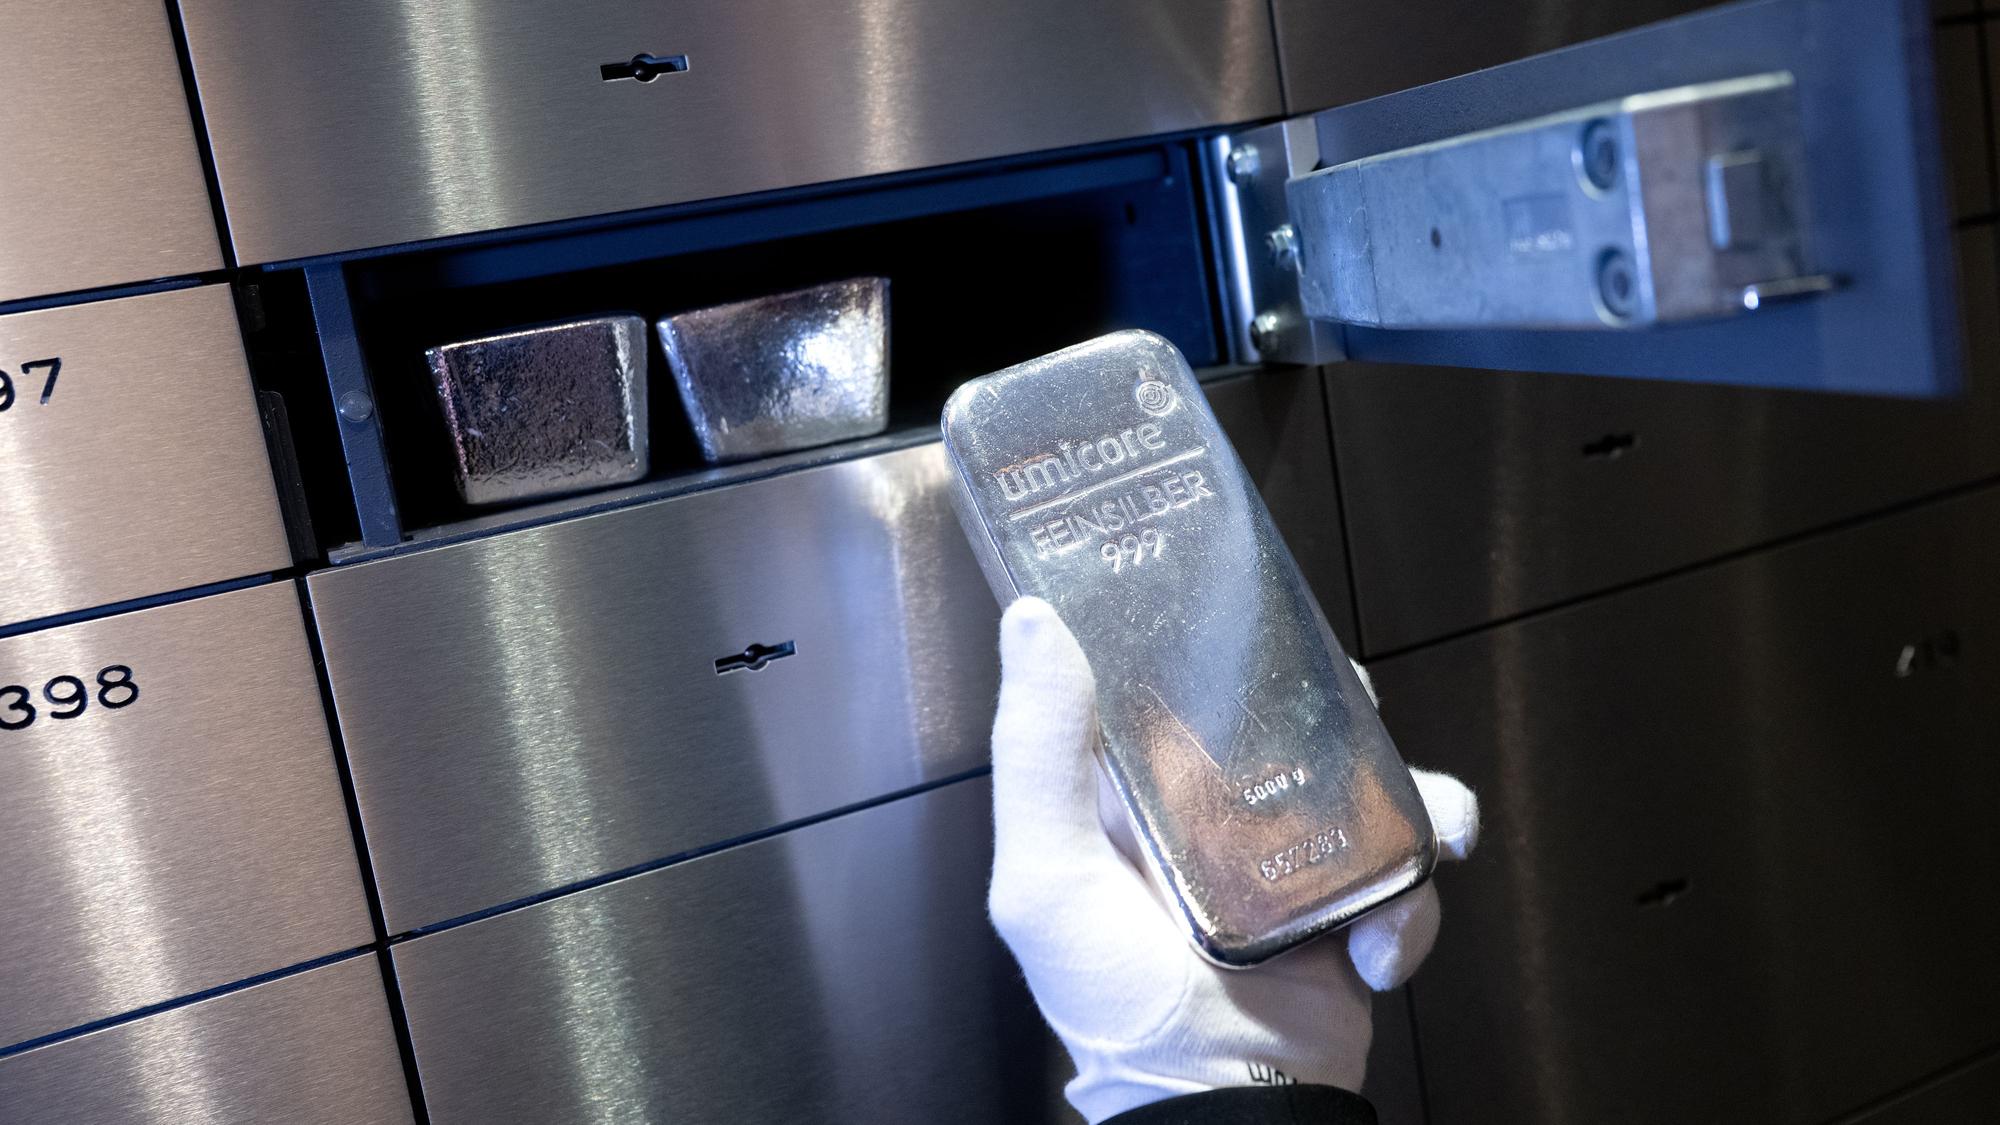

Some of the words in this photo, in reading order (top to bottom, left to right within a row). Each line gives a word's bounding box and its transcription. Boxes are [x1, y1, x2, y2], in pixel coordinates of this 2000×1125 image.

[994, 421, 1166, 501] umicore
[1029, 470, 1213, 560] FEINSILBER
[1100, 527, 1162, 574] 999
[0, 664, 140, 731] 398
[1242, 772, 1289, 805] 5000
[1291, 767, 1306, 786] g
